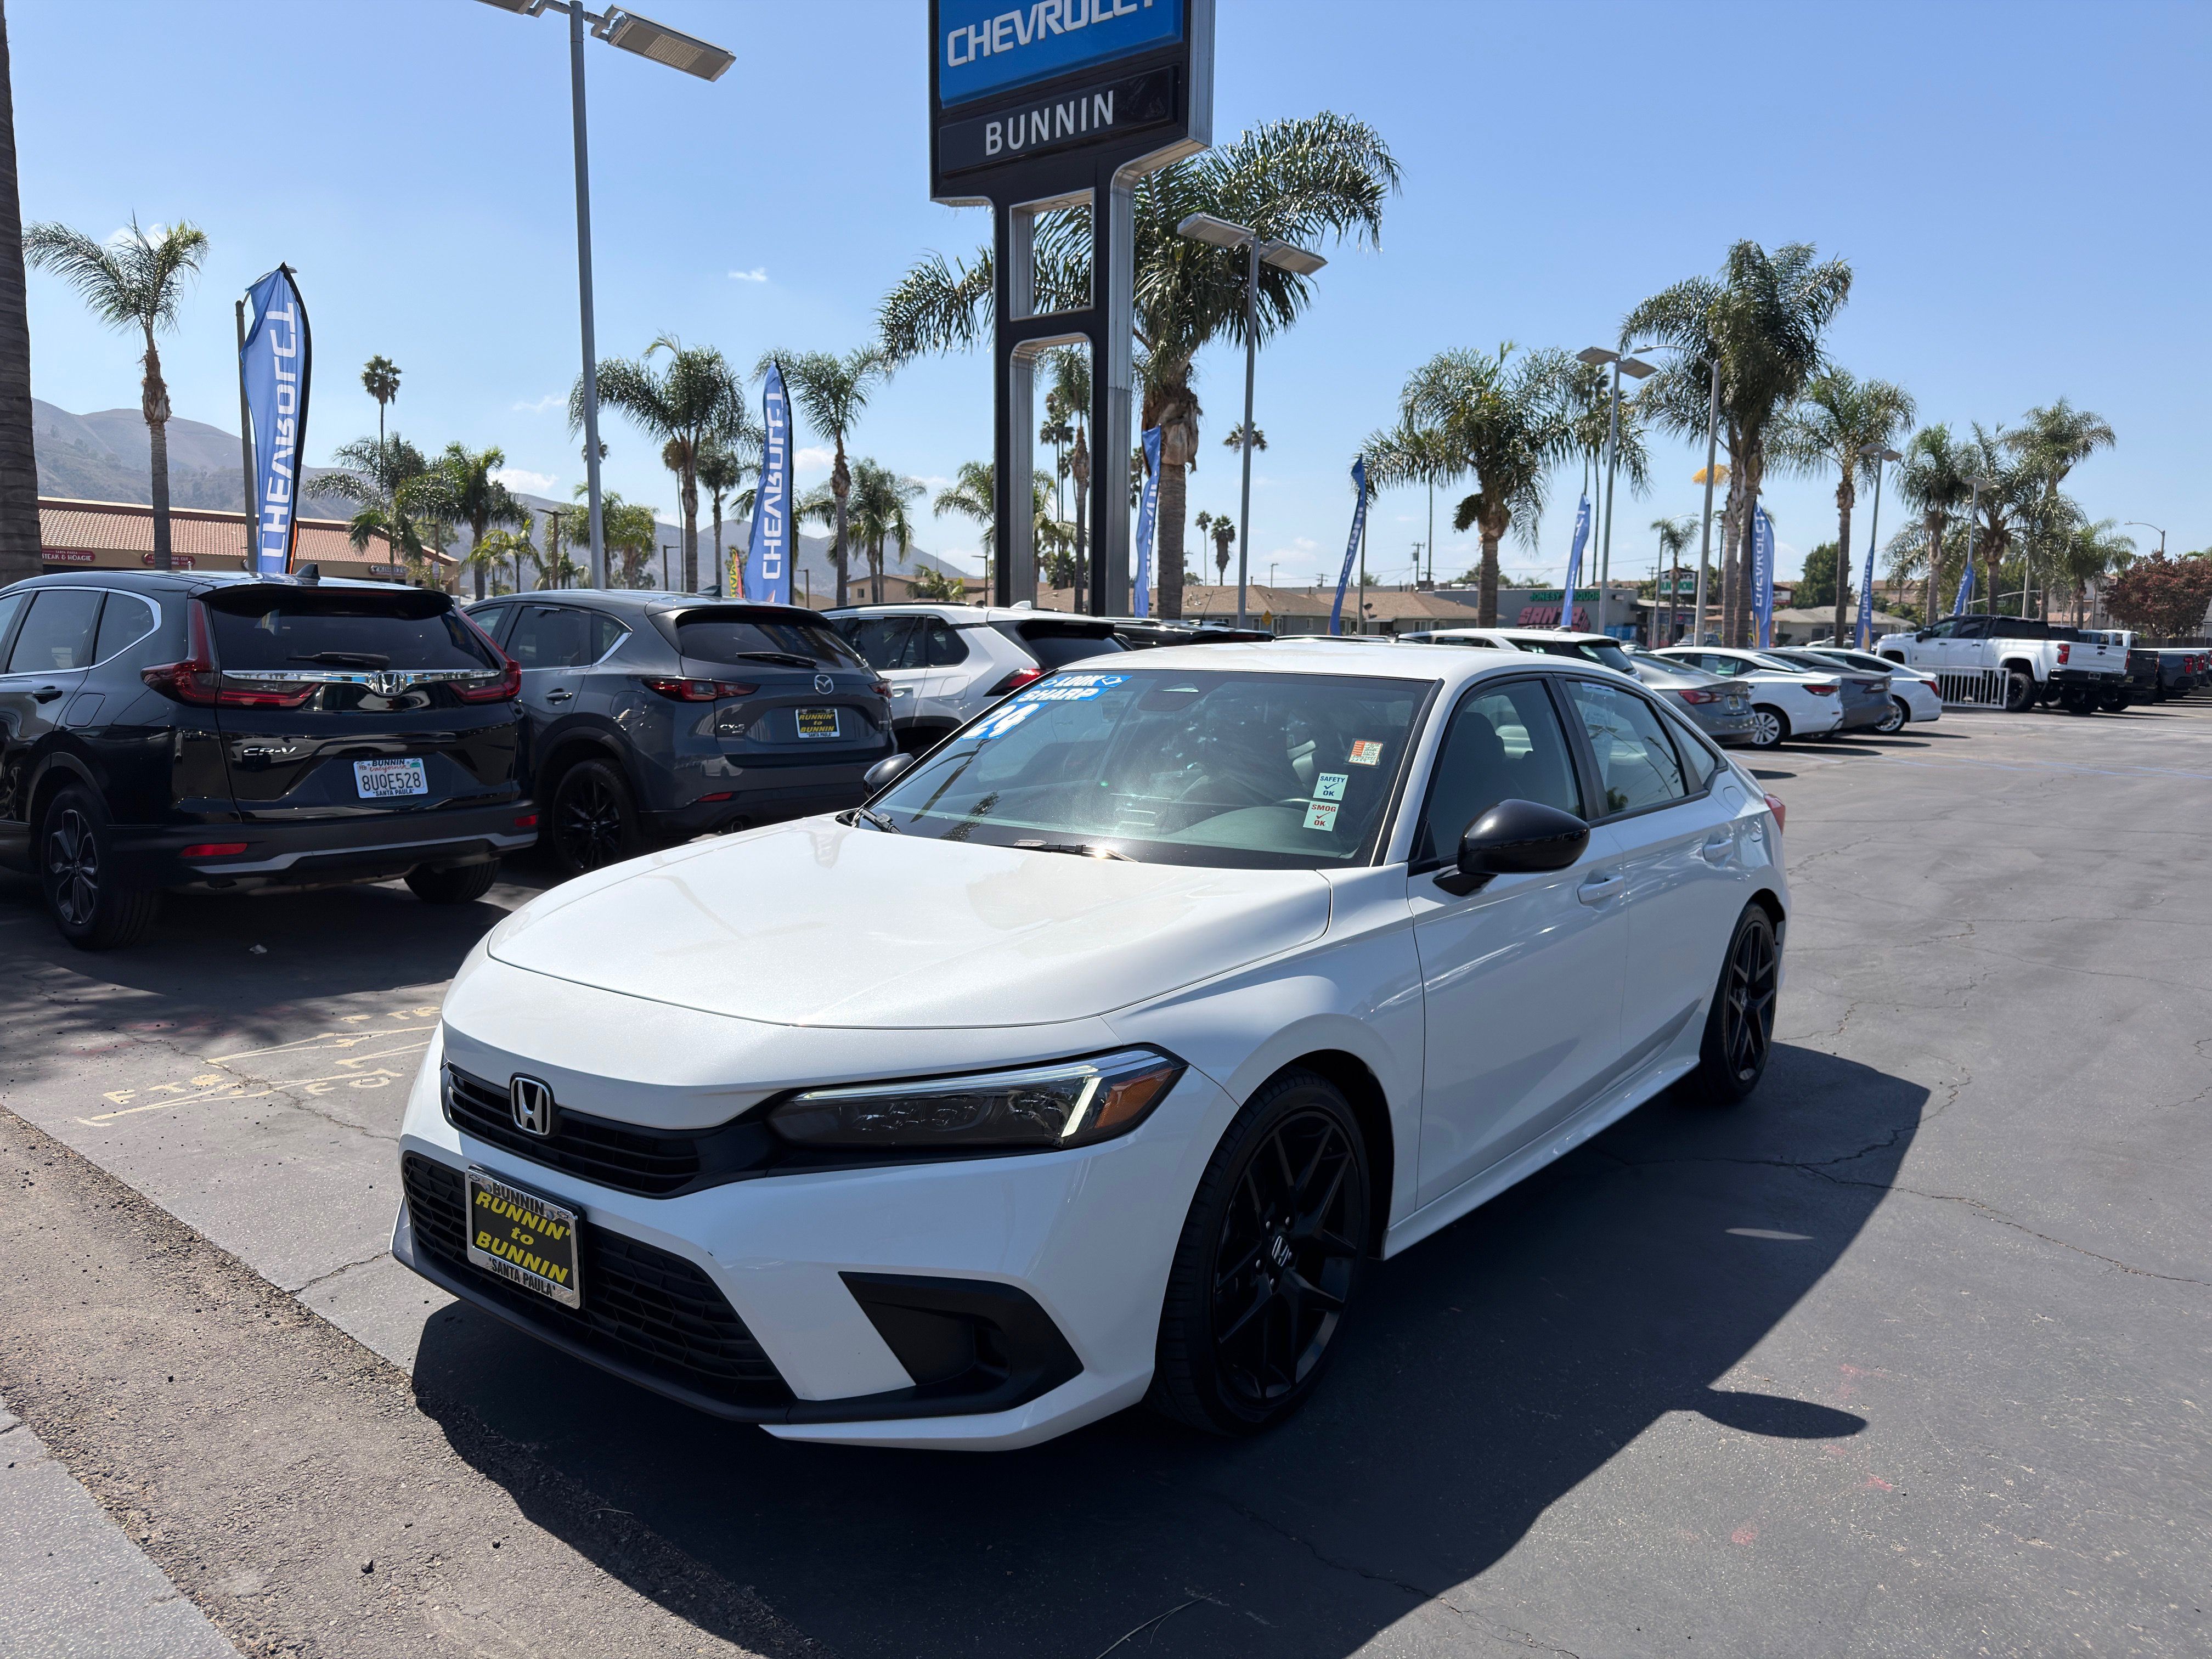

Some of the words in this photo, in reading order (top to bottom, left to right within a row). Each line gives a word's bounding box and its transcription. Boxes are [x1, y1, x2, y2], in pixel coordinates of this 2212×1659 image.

[947, 0, 1153, 67] CHEVROL
[985, 90, 1115, 156] BUNNIN
[1530, 591, 1565, 601] JONESY'
[1573, 591, 1600, 601] IQUOR
[1053, 675, 1106, 687] LOOK
[1017, 687, 1099, 702] SHARP
[961, 703, 1040, 739] 24
[243, 747, 297, 756] CR-V
[362, 772, 421, 792] 8UQE528
[1319, 775, 1346, 783] SAFETY
[493, 1184, 545, 1215] BUNNIN
[475, 1190, 571, 1240] RUNNIN'
[511, 1227, 535, 1245] to
[475, 1231, 569, 1283] BUNNIN
